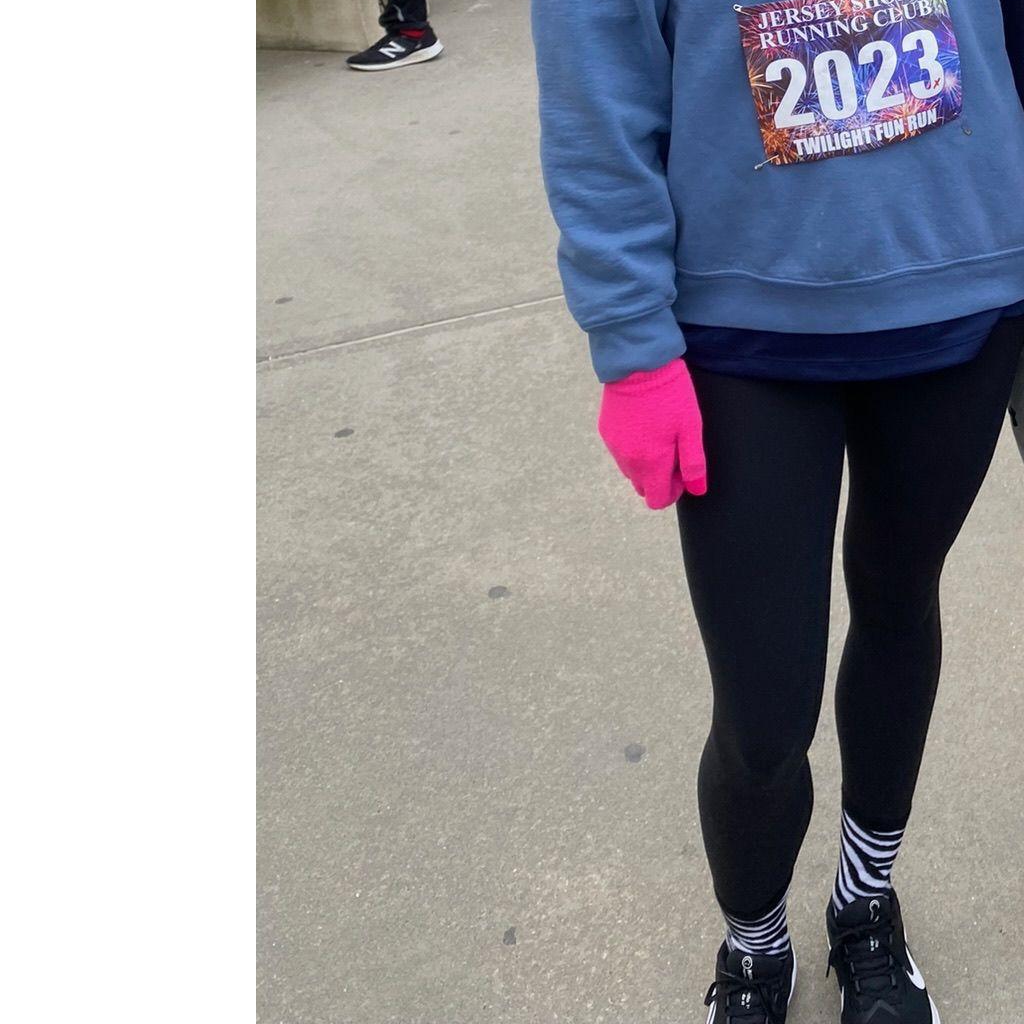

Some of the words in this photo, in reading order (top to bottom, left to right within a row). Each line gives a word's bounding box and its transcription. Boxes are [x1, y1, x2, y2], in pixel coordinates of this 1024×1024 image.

[758, 0, 845, 30] JERSEY
[758, 14, 869, 50] RUNNING
[765, 29, 945, 129] 2023
[793, 126, 873, 156] TWILIGHT
[876, 118, 904, 142] FUN
[907, 109, 937, 132] RUN
